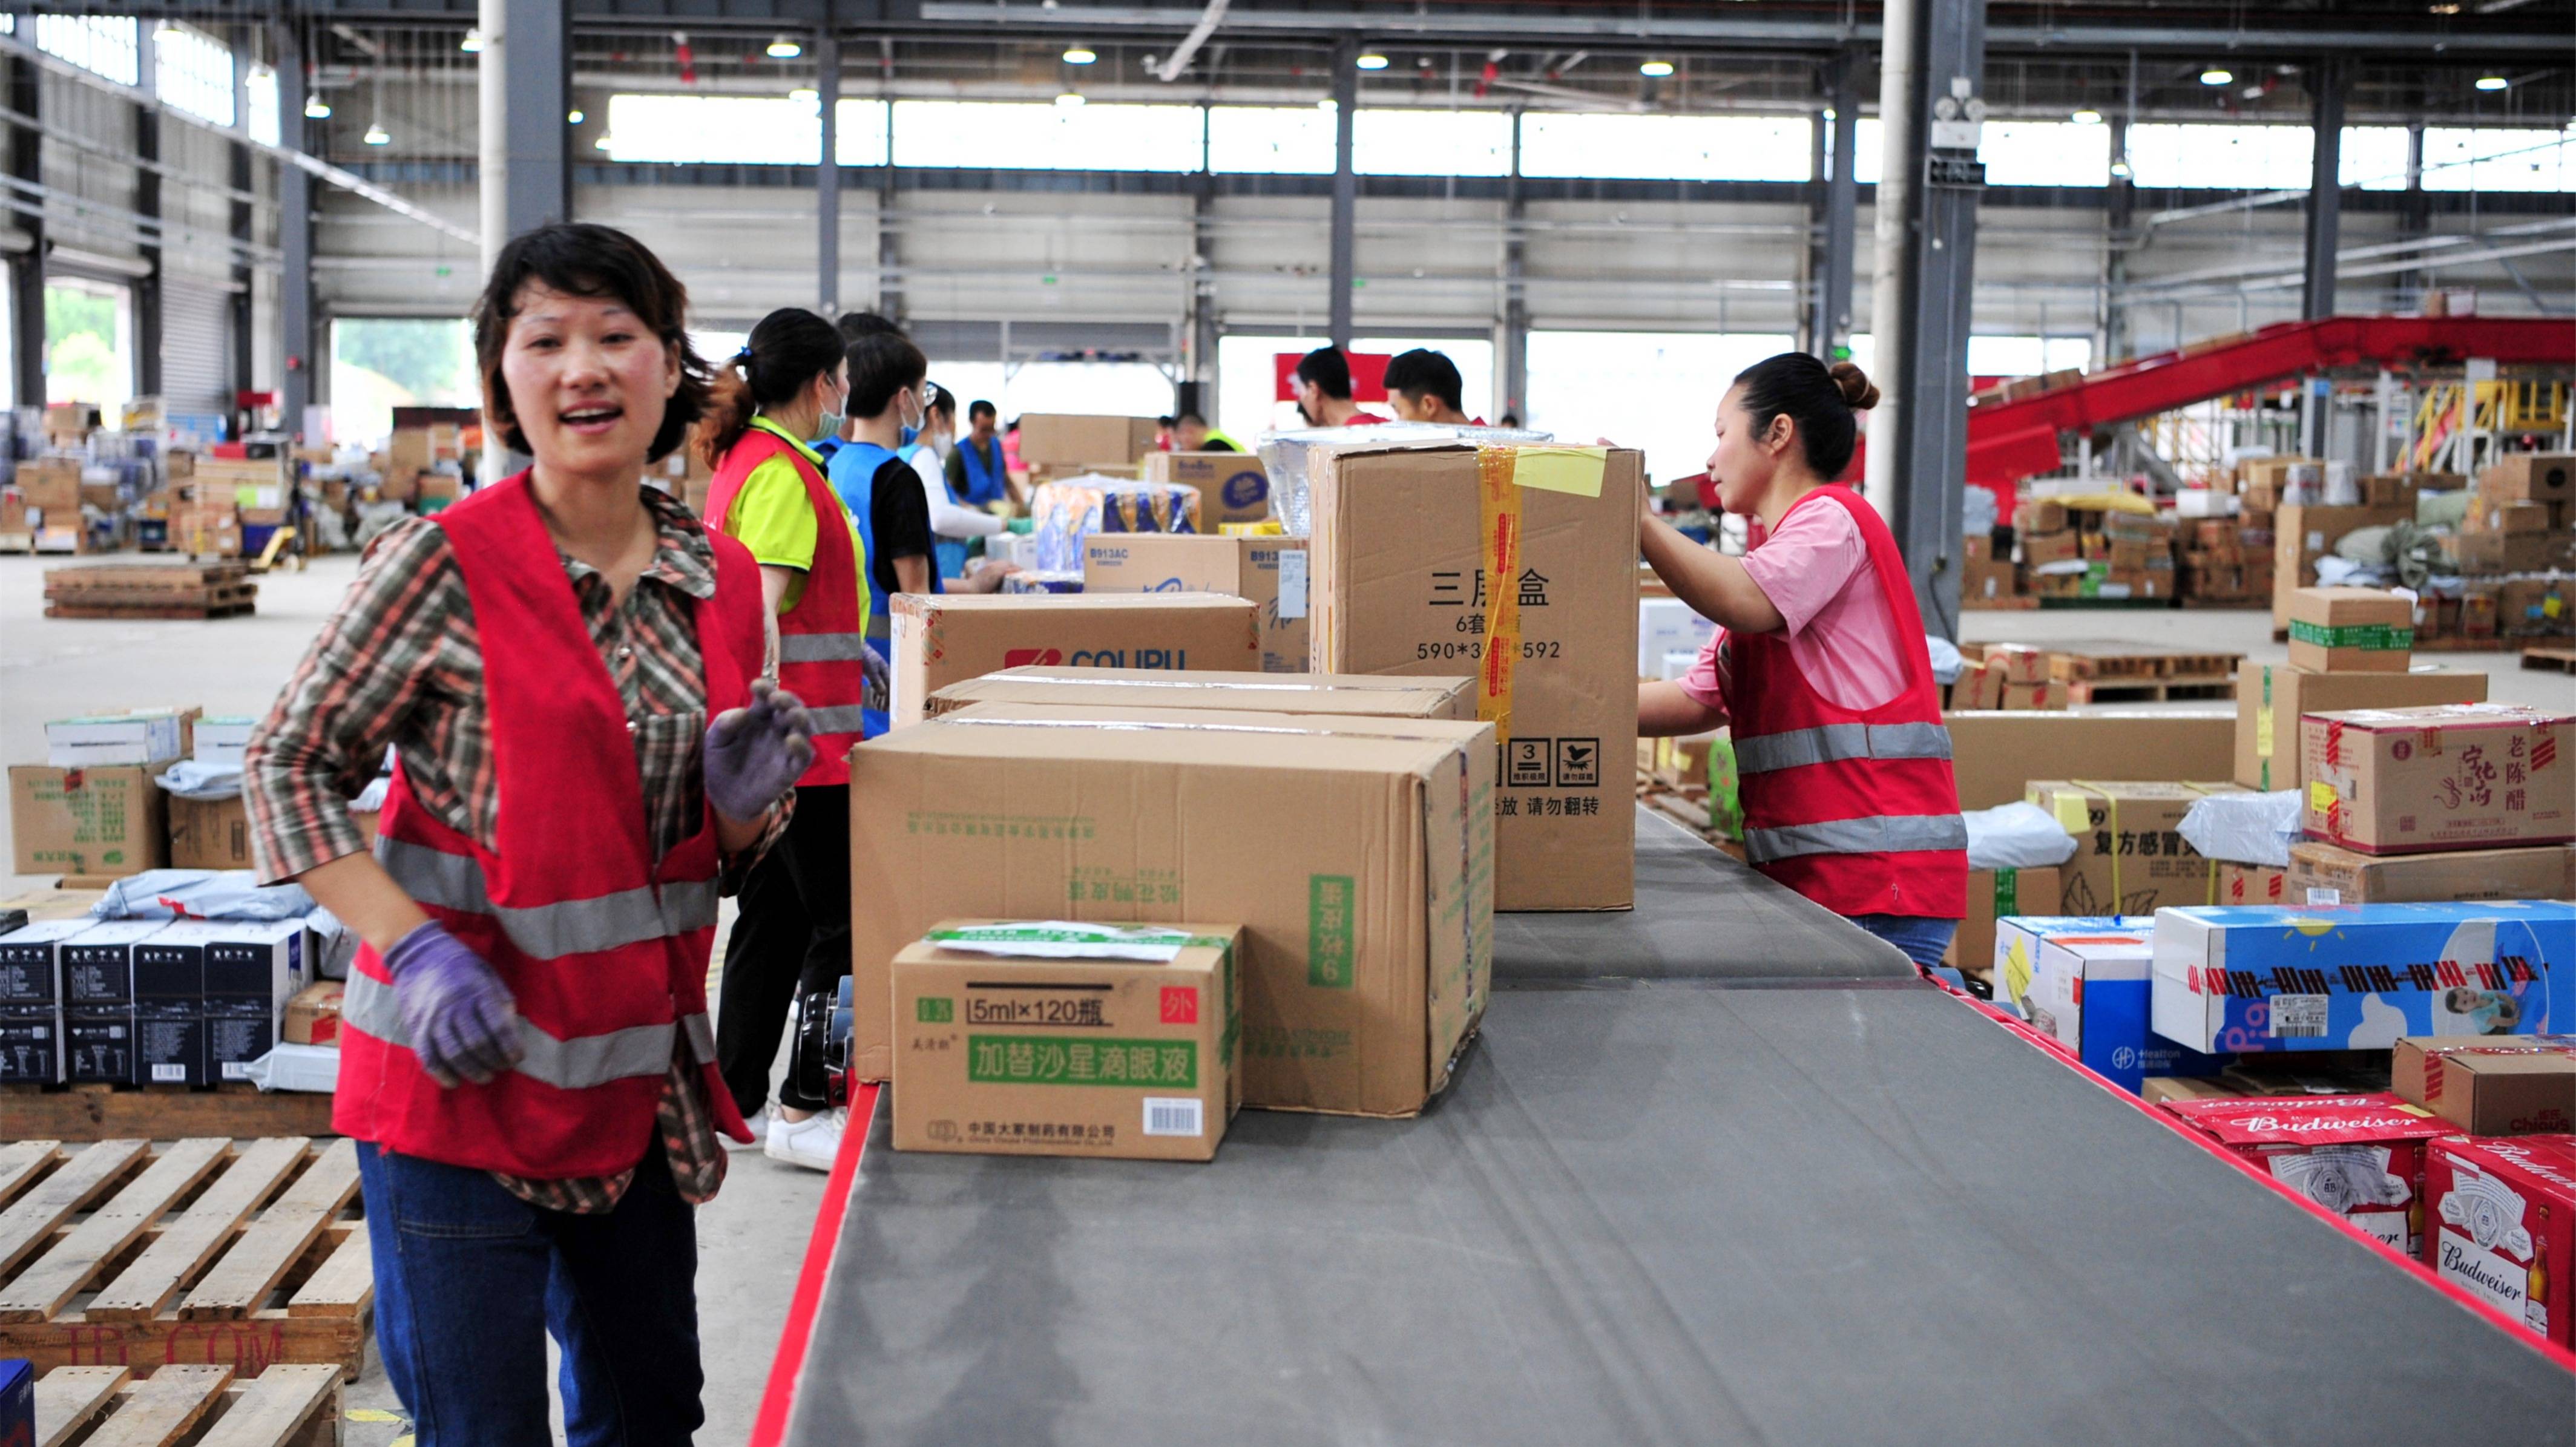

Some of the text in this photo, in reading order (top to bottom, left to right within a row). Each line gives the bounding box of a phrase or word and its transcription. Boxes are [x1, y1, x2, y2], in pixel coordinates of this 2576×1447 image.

[1091, 548, 1128, 559] B913AC
[1250, 550, 1278, 562] B913
[1522, 744, 1536, 760] 3
[2506, 735, 2526, 811] 老陈醋
[1527, 796, 1599, 816] 请勿翻转
[974, 998, 1103, 1025] 5ml×120瓶
[1165, 994, 1194, 1019] 外
[976, 1043, 1191, 1081] 加替沙星滴眼液
[2201, 1098, 2384, 1109] Budweiser
[2230, 1116, 2420, 1132] Budweiser
[2442, 1241, 2521, 1301] Budweiser
